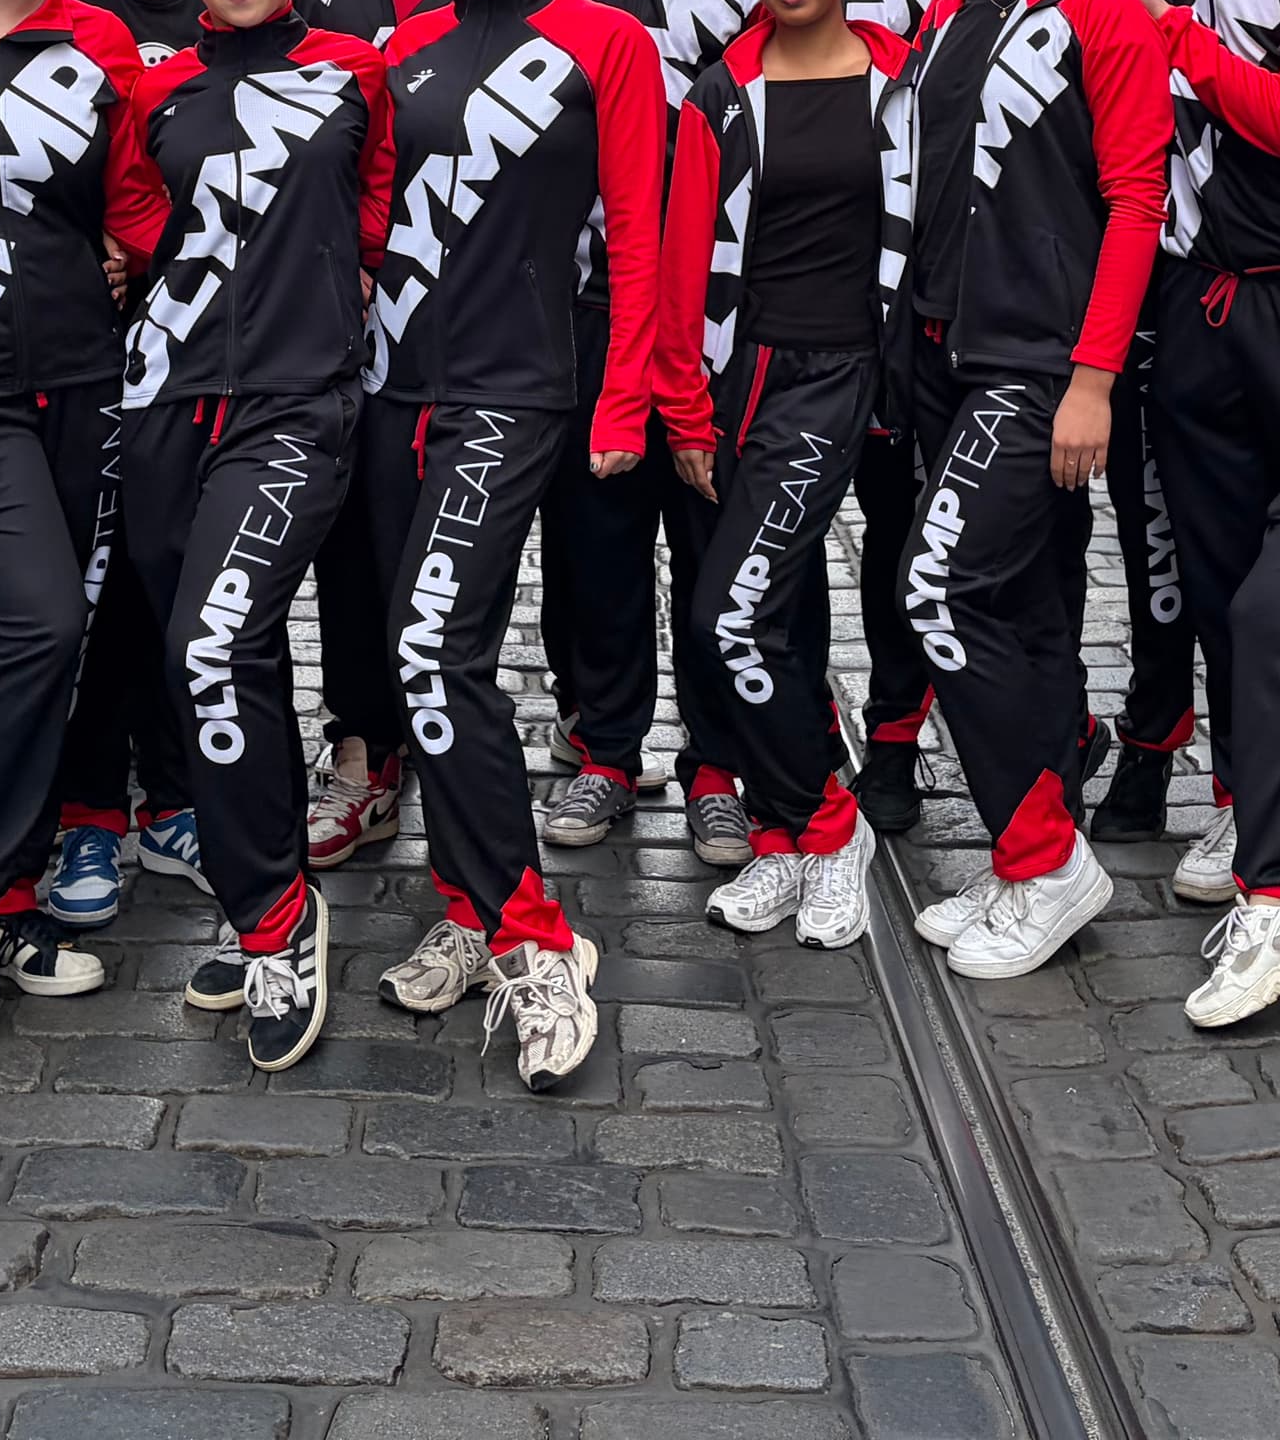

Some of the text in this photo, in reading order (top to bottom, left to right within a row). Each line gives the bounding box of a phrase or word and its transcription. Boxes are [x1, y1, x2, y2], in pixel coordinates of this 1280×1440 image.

[122, 61, 354, 410] OLYMP
[186, 434, 316, 765] OLYMPTEAM
[398, 410, 516, 755] OLYMPTEAM
[716, 431, 833, 705] OLYMPTEAM
[906, 384, 1027, 673] OLYMPTEAM
